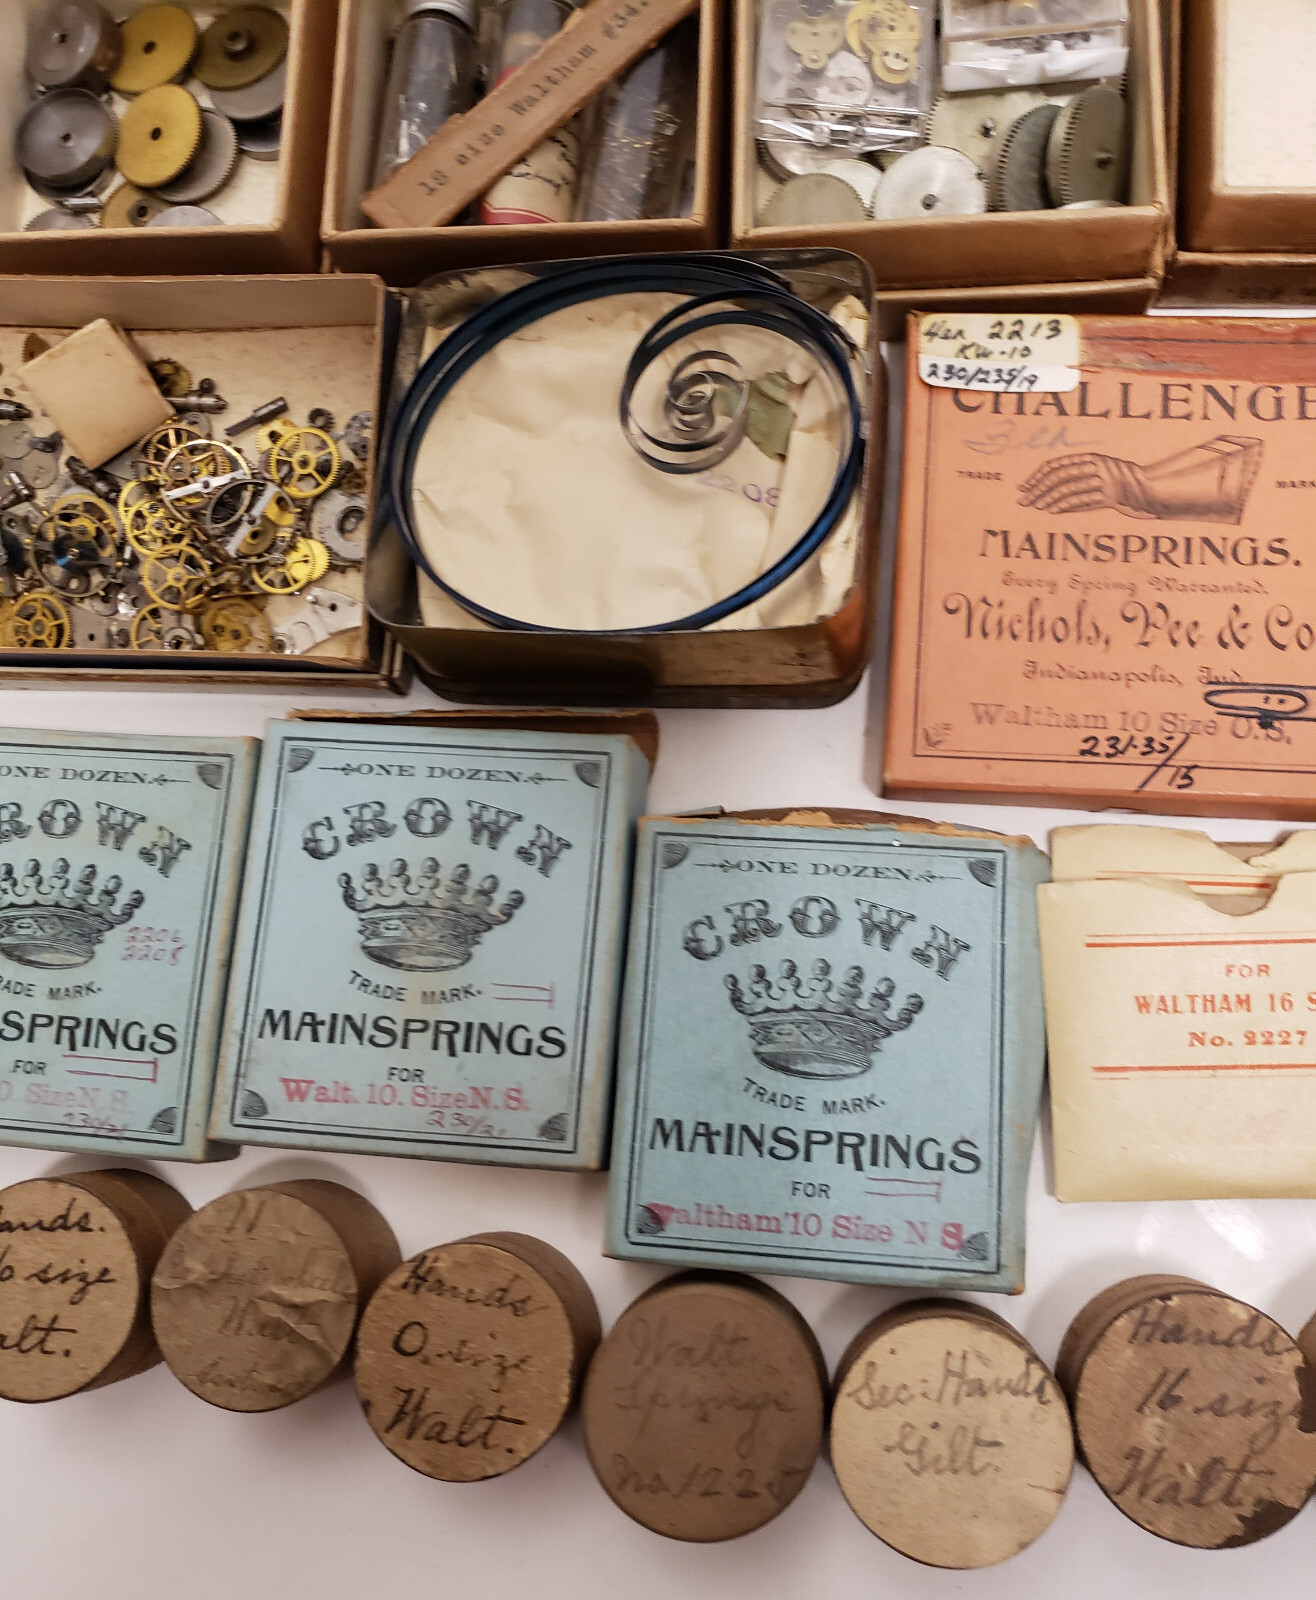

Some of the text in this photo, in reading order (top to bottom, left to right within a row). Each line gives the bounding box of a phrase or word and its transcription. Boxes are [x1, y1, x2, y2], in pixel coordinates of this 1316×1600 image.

[979, 529, 1303, 569] MAINSPRINGS.
[942, 592, 1112, 654] Nichols,
[1216, 603, 1253, 650] &
[969, 702, 1109, 731] Waltham
[1120, 709, 1152, 734] 10
[1159, 711, 1218, 738] Size
[0, 765, 49, 780] ONE
[358, 763, 416, 778] ONE
[301, 797, 573, 878] CROWN
[737, 859, 799, 874] ONE
[682, 895, 972, 982] CROWN
[349, 970, 408, 1002] TRADE
[1224, 963, 1272, 978] FOR
[1133, 993, 1252, 1016] WALTHAM
[1268, 991, 1294, 1013] 16
[0, 1010, 179, 1056] SPRINGS
[257, 1008, 567, 1059] MAINSPRINGS
[1188, 1029, 1308, 1047] No. 2227
[12, 1059, 48, 1077] FOR
[387, 1066, 424, 1083] FOR
[743, 1077, 807, 1112] TRADE
[648, 1117, 982, 1175] MAINSPRINGS
[791, 1180, 831, 1199] FOR
[0, 1198, 106, 1233] ands.
[831, 1215, 894, 1244] Size
[24, 1258, 118, 1306] size
